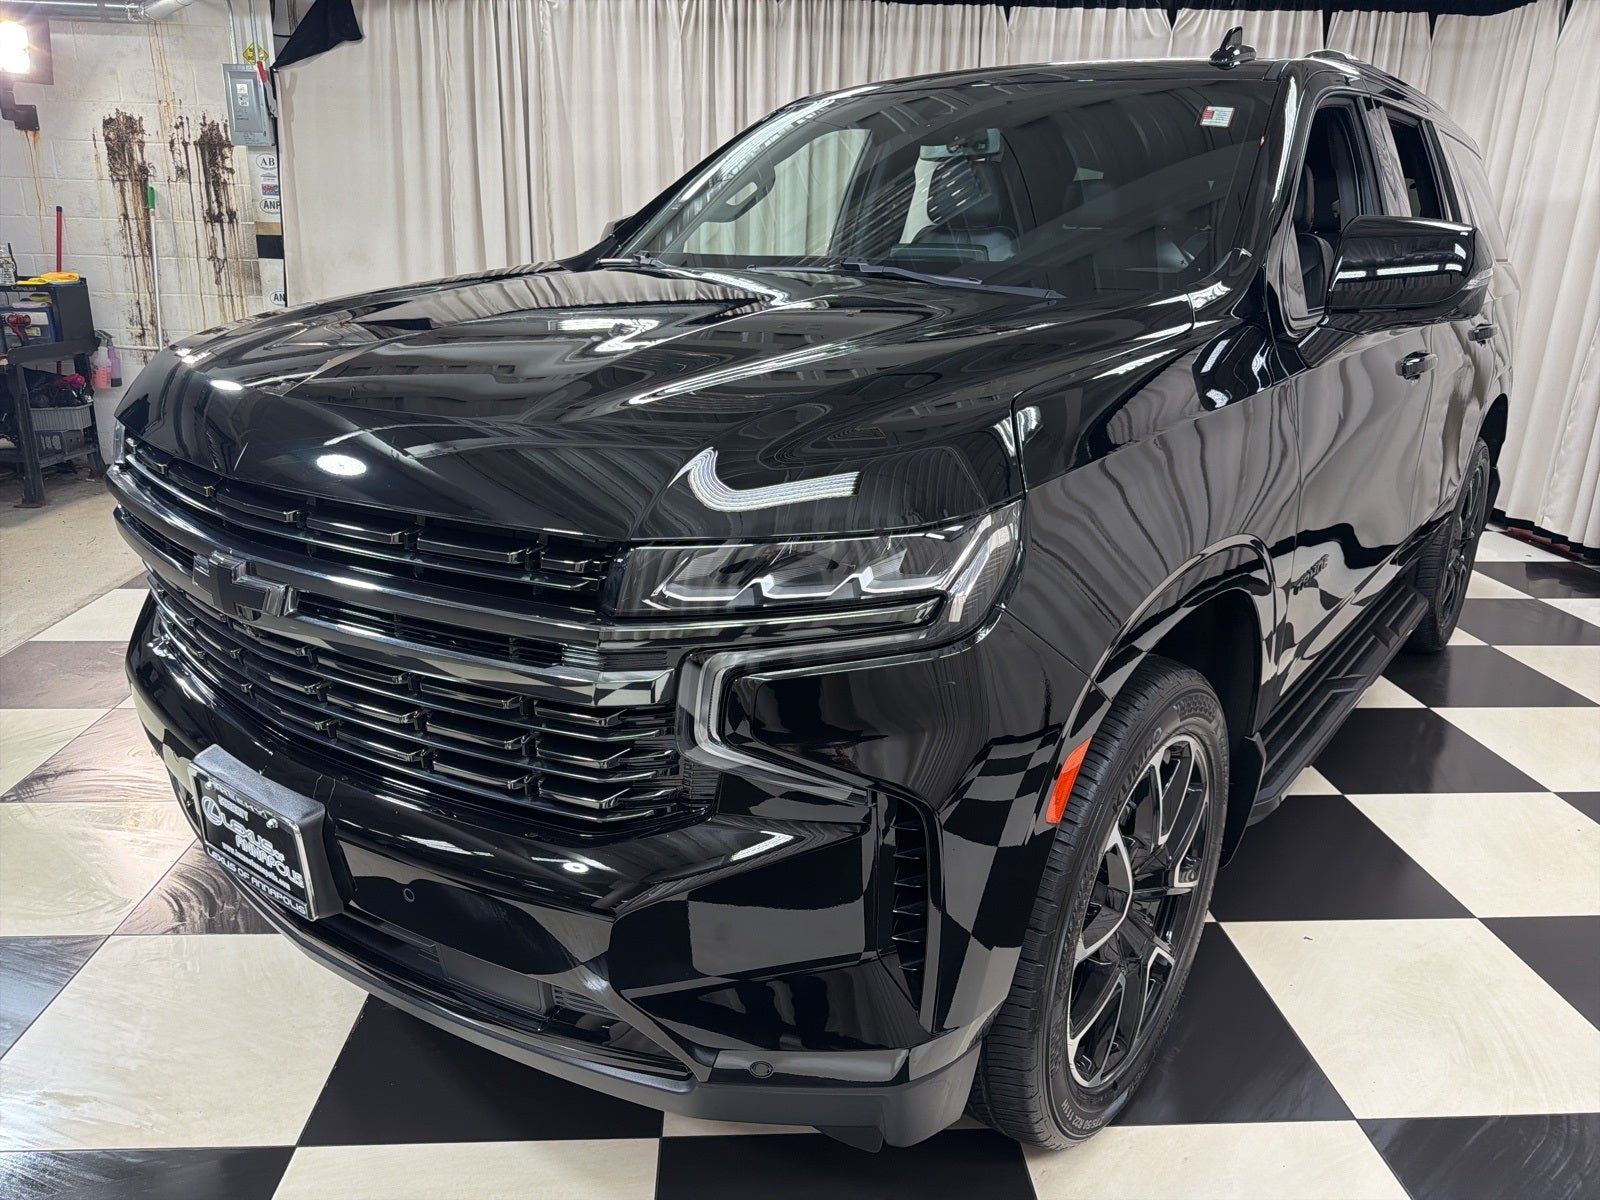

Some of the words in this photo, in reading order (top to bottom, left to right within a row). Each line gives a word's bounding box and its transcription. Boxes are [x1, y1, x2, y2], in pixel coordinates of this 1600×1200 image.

[221, 811, 275, 857] LEXUS
[234, 834, 305, 889] ANNAPOLIS
[206, 847, 237, 873] LEXUS
[237, 867, 251, 880] OF
[250, 875, 306, 915] ANNAPOLIS
